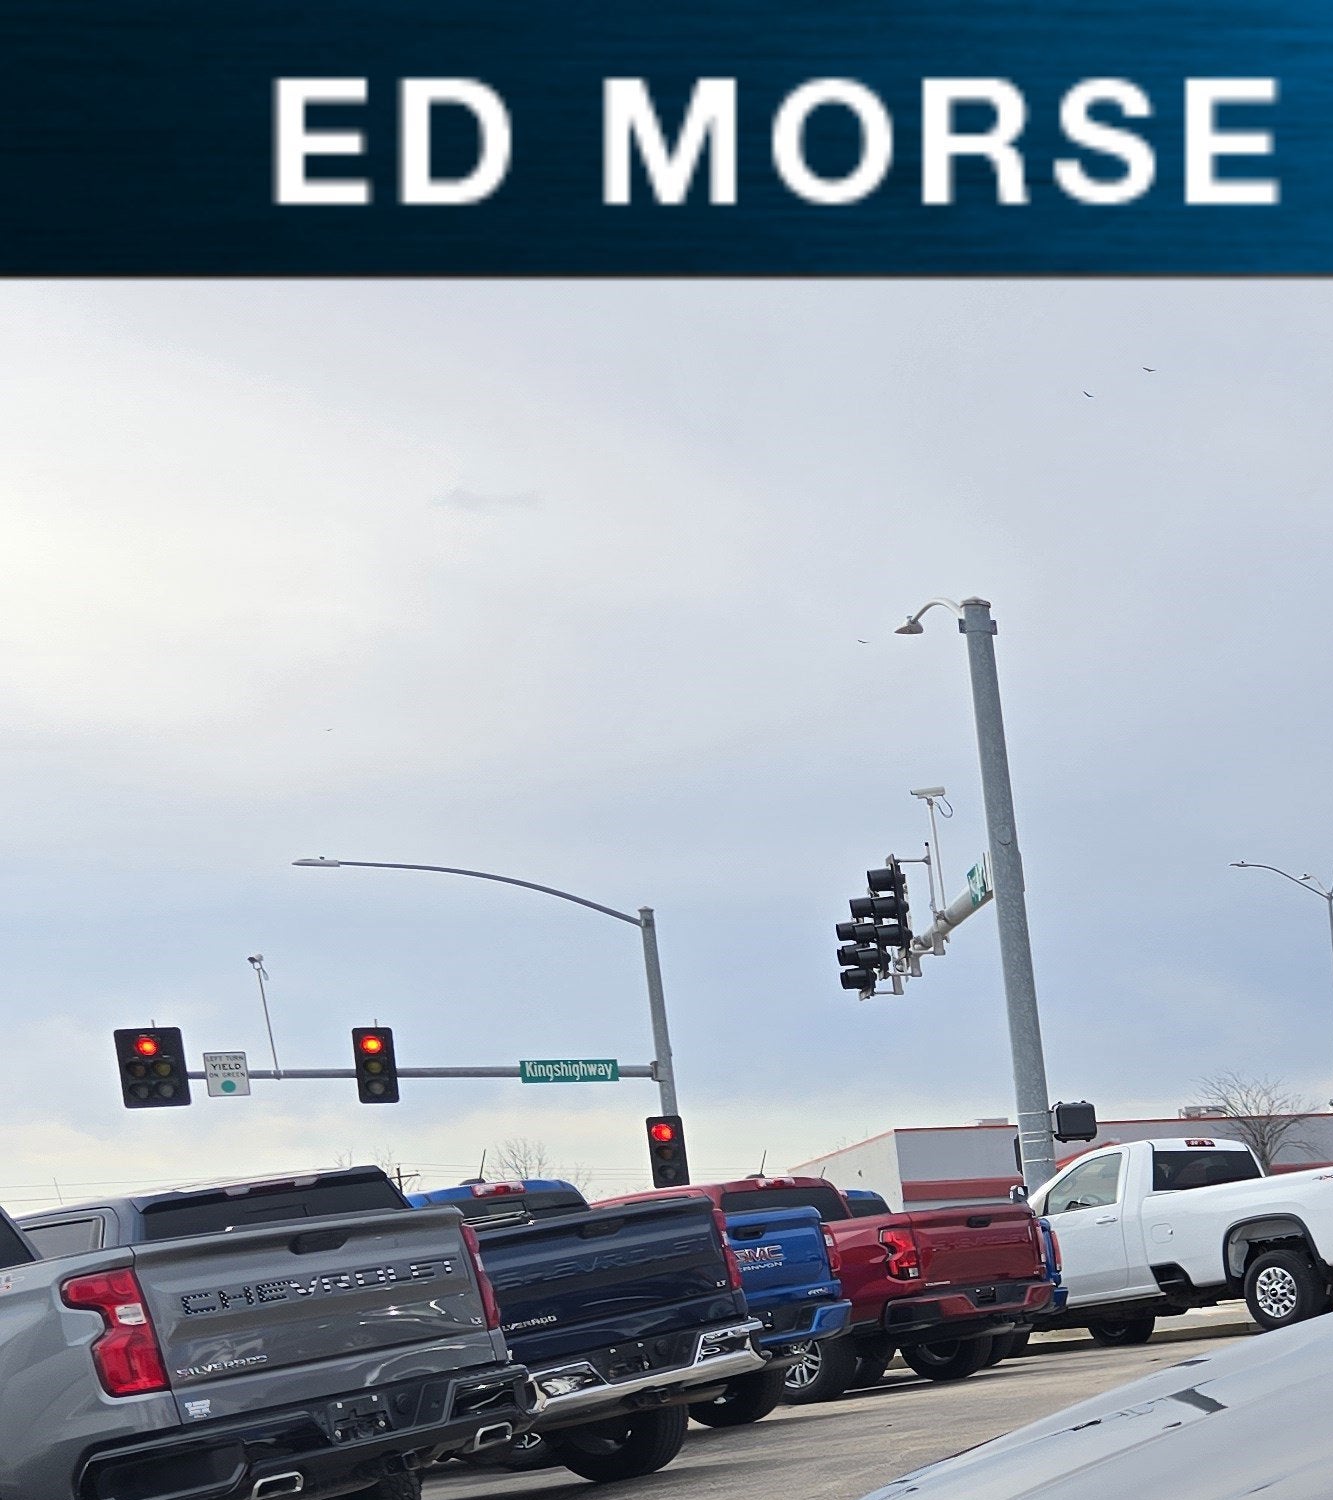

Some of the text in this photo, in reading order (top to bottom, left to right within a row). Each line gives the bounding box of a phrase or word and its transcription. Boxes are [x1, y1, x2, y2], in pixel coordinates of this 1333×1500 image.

[210, 1063, 241, 1071] YIELD
[525, 1061, 613, 1081] Kingshighway
[181, 1256, 458, 1316] CHEVROLET
[716, 1279, 727, 1288] LT
[176, 1355, 268, 1378] SILVERADO
